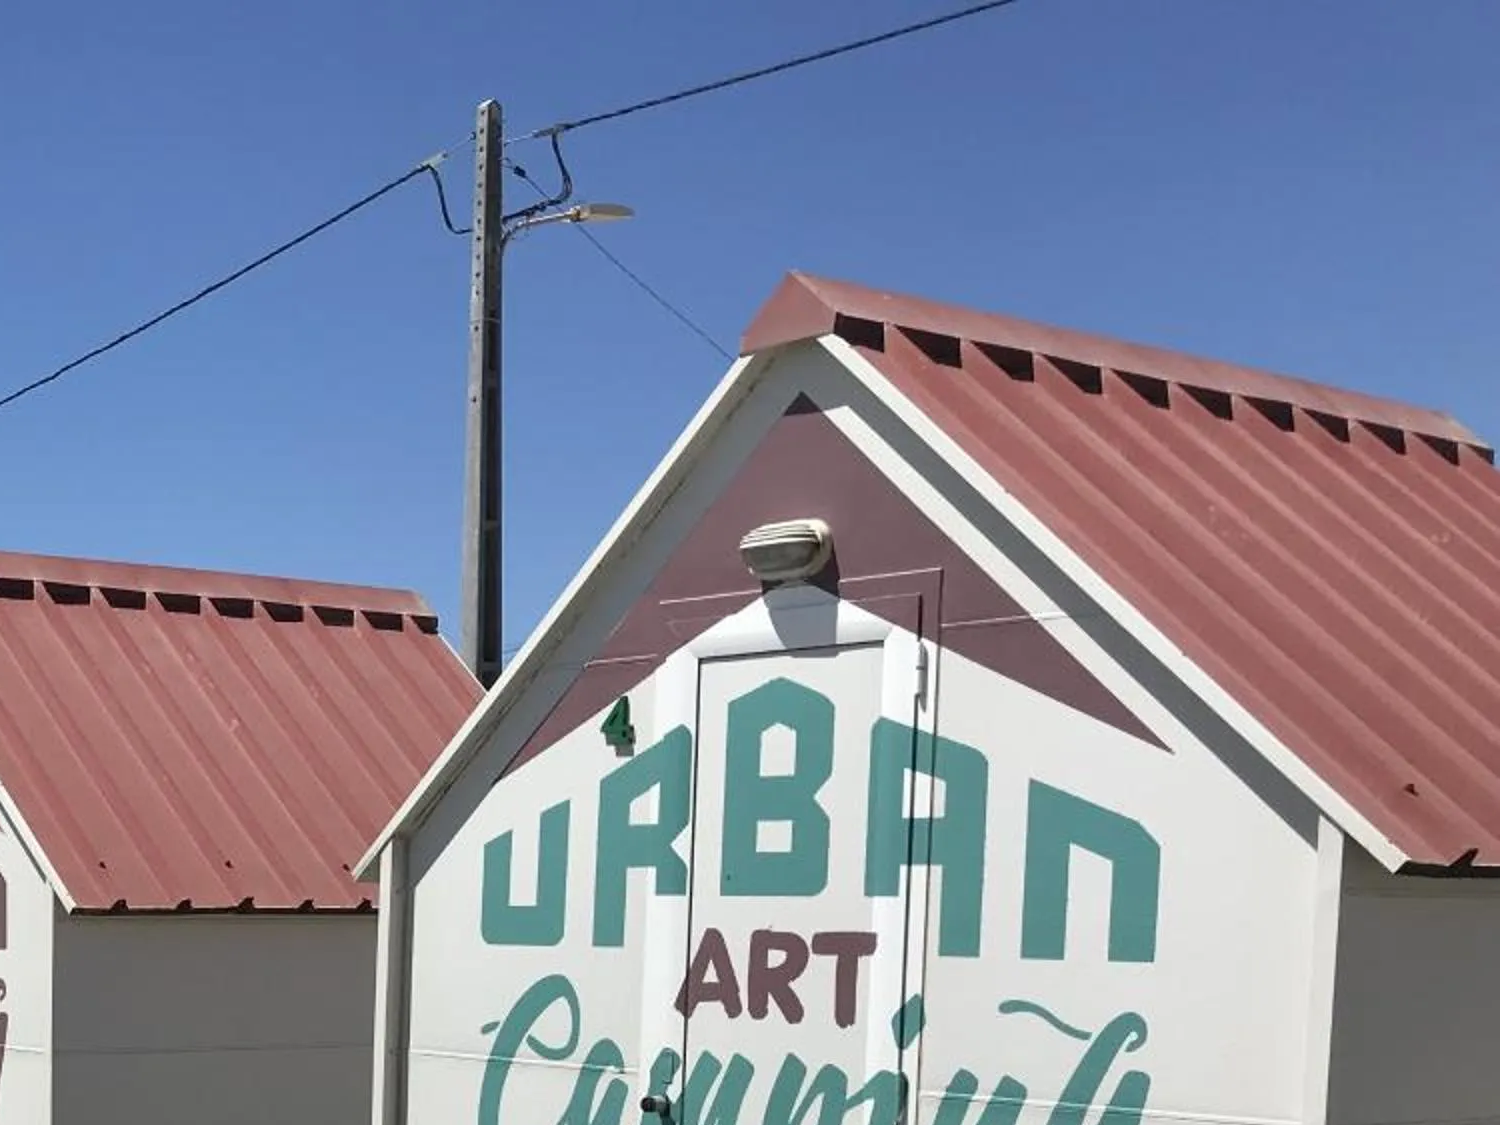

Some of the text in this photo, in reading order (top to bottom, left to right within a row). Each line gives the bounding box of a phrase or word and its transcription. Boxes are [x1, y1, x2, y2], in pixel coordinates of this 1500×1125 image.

[600, 696, 636, 748] 4
[480, 676, 1161, 963] URBAN
[674, 927, 878, 1028] ART
